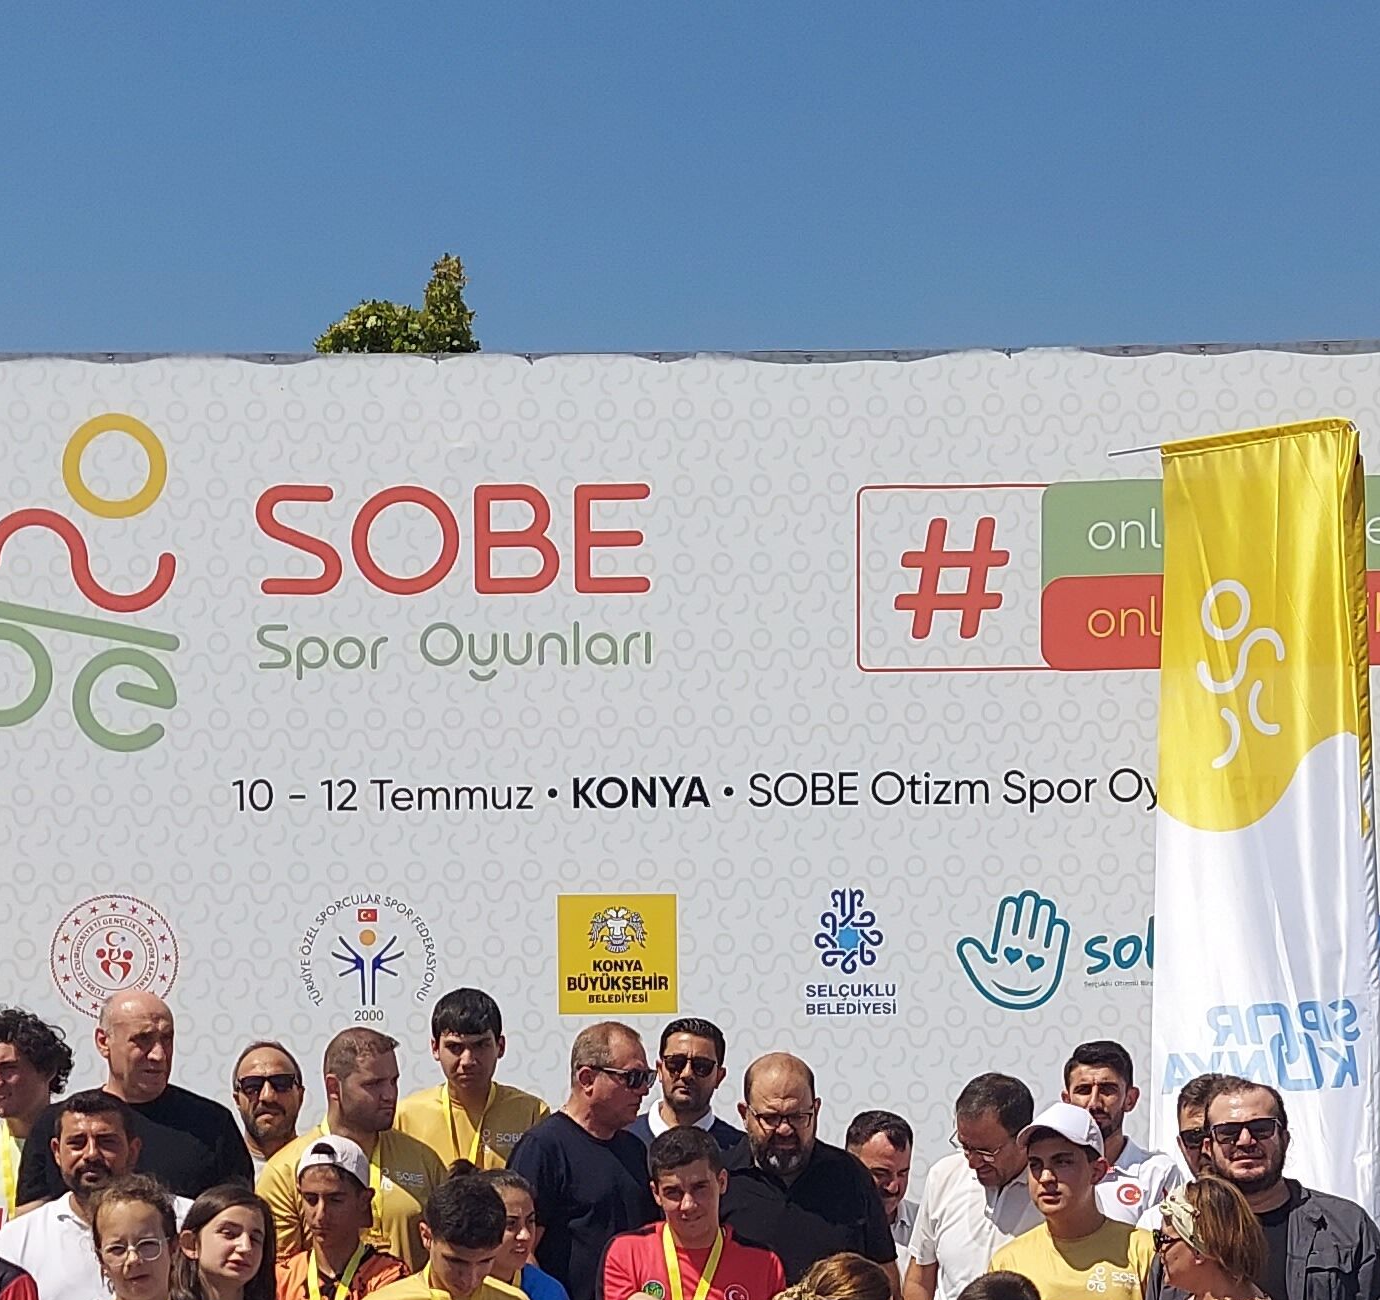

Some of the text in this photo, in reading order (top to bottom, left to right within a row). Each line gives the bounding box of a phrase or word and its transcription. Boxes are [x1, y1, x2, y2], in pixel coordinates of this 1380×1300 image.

[255, 482, 651, 595] SOBE
[1087, 507, 1162, 550] onl
[1087, 595, 1161, 638] onl
[256, 620, 652, 682] Spor Oyunları
[231, 778, 274, 812] 10
[320, 778, 358, 812] 12
[370, 778, 534, 812] Temmuz
[571, 775, 711, 809] KONYA
[748, 771, 859, 807] SOBE
[871, 770, 990, 806] Otizm
[1002, 769, 1098, 813] Spor
[1108, 767, 1158, 811] Oy
[299, 926, 320, 956] ÖZEL
[315, 893, 381, 926] SPORCULAR
[384, 896, 414, 920] SPOR
[411, 916, 437, 1002] FEDERASYONU
[592, 959, 643, 973] KONYA
[566, 973, 669, 994] BÜYÜKŞEHİR
[588, 991, 648, 1004] BELEDİYESİ
[806, 983, 896, 1000] SELÇUKLU
[354, 1009, 384, 1021] 2000
[806, 998, 897, 1015] BELEDİYESİ
